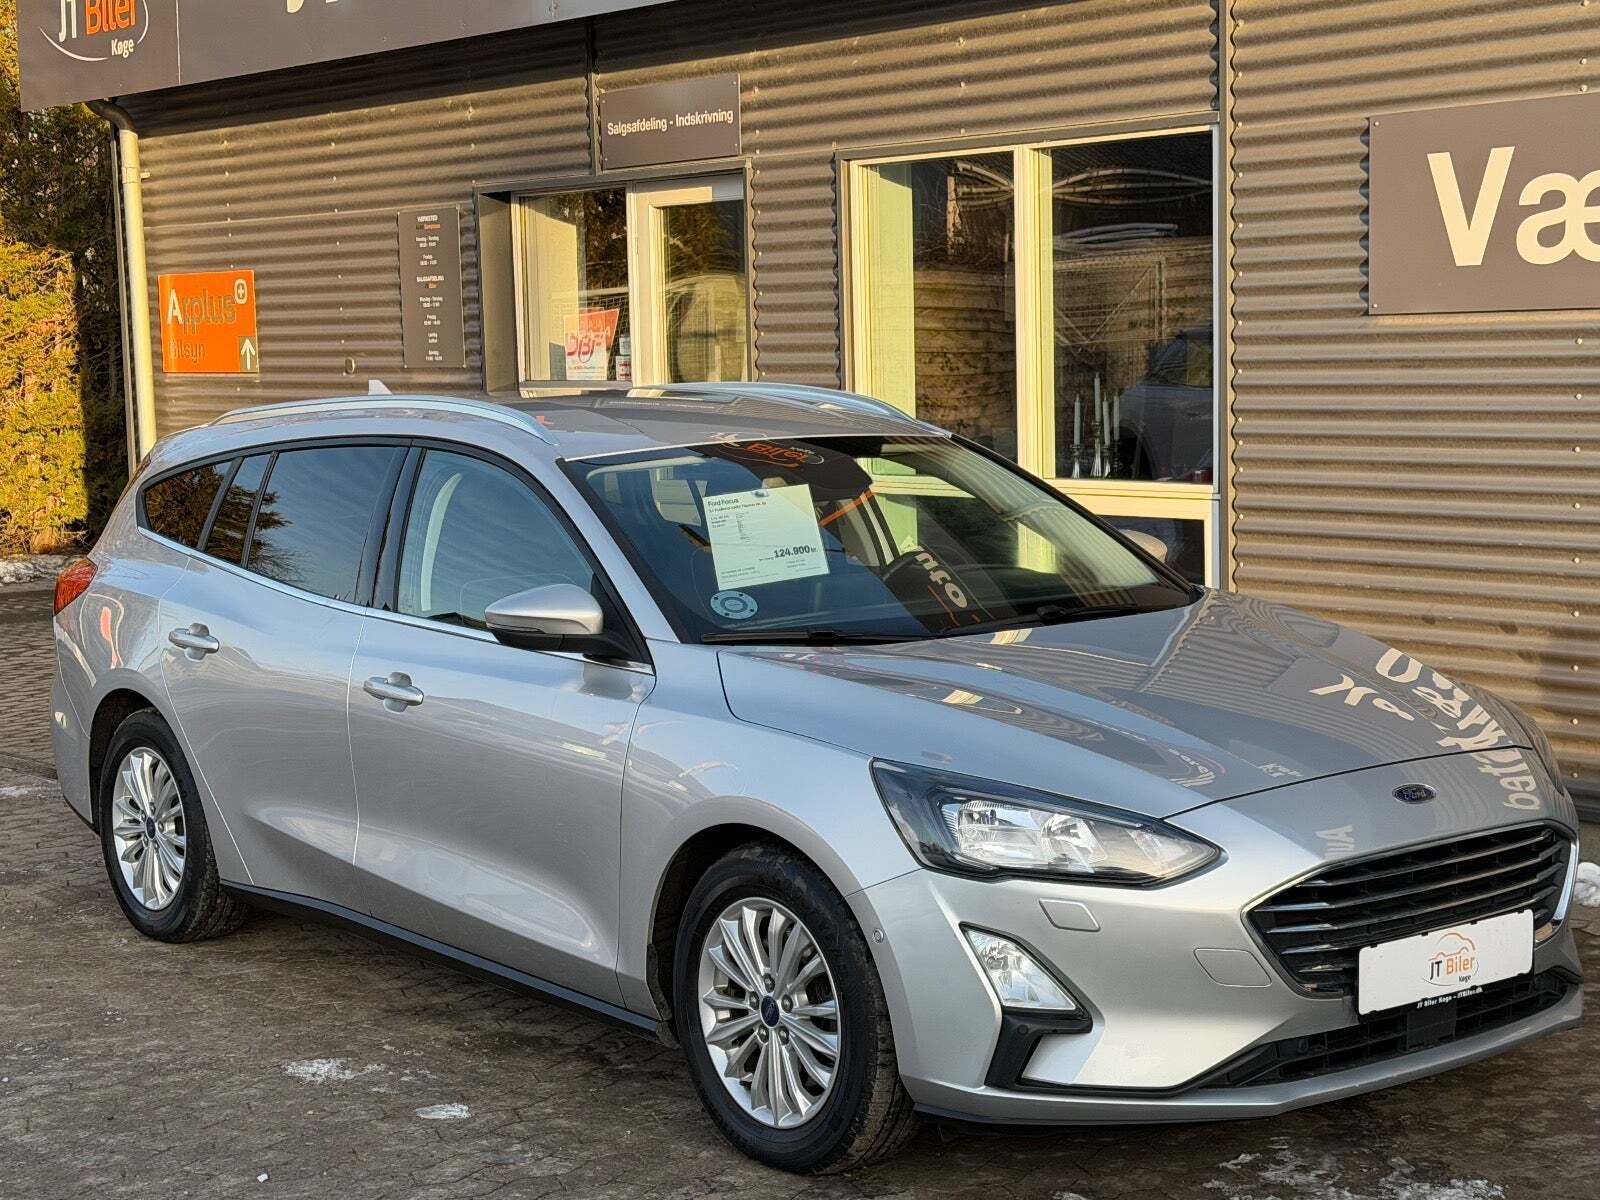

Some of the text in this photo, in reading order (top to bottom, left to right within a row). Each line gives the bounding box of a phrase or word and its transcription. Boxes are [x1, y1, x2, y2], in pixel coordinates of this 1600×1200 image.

[111, 38, 135, 58] Køge
[607, 118, 668, 136] Salgsafdeling
[675, 109, 734, 127] Indskrivning
[1429, 955, 1475, 981] JT Biler
[1424, 999, 1438, 1007] Biler
